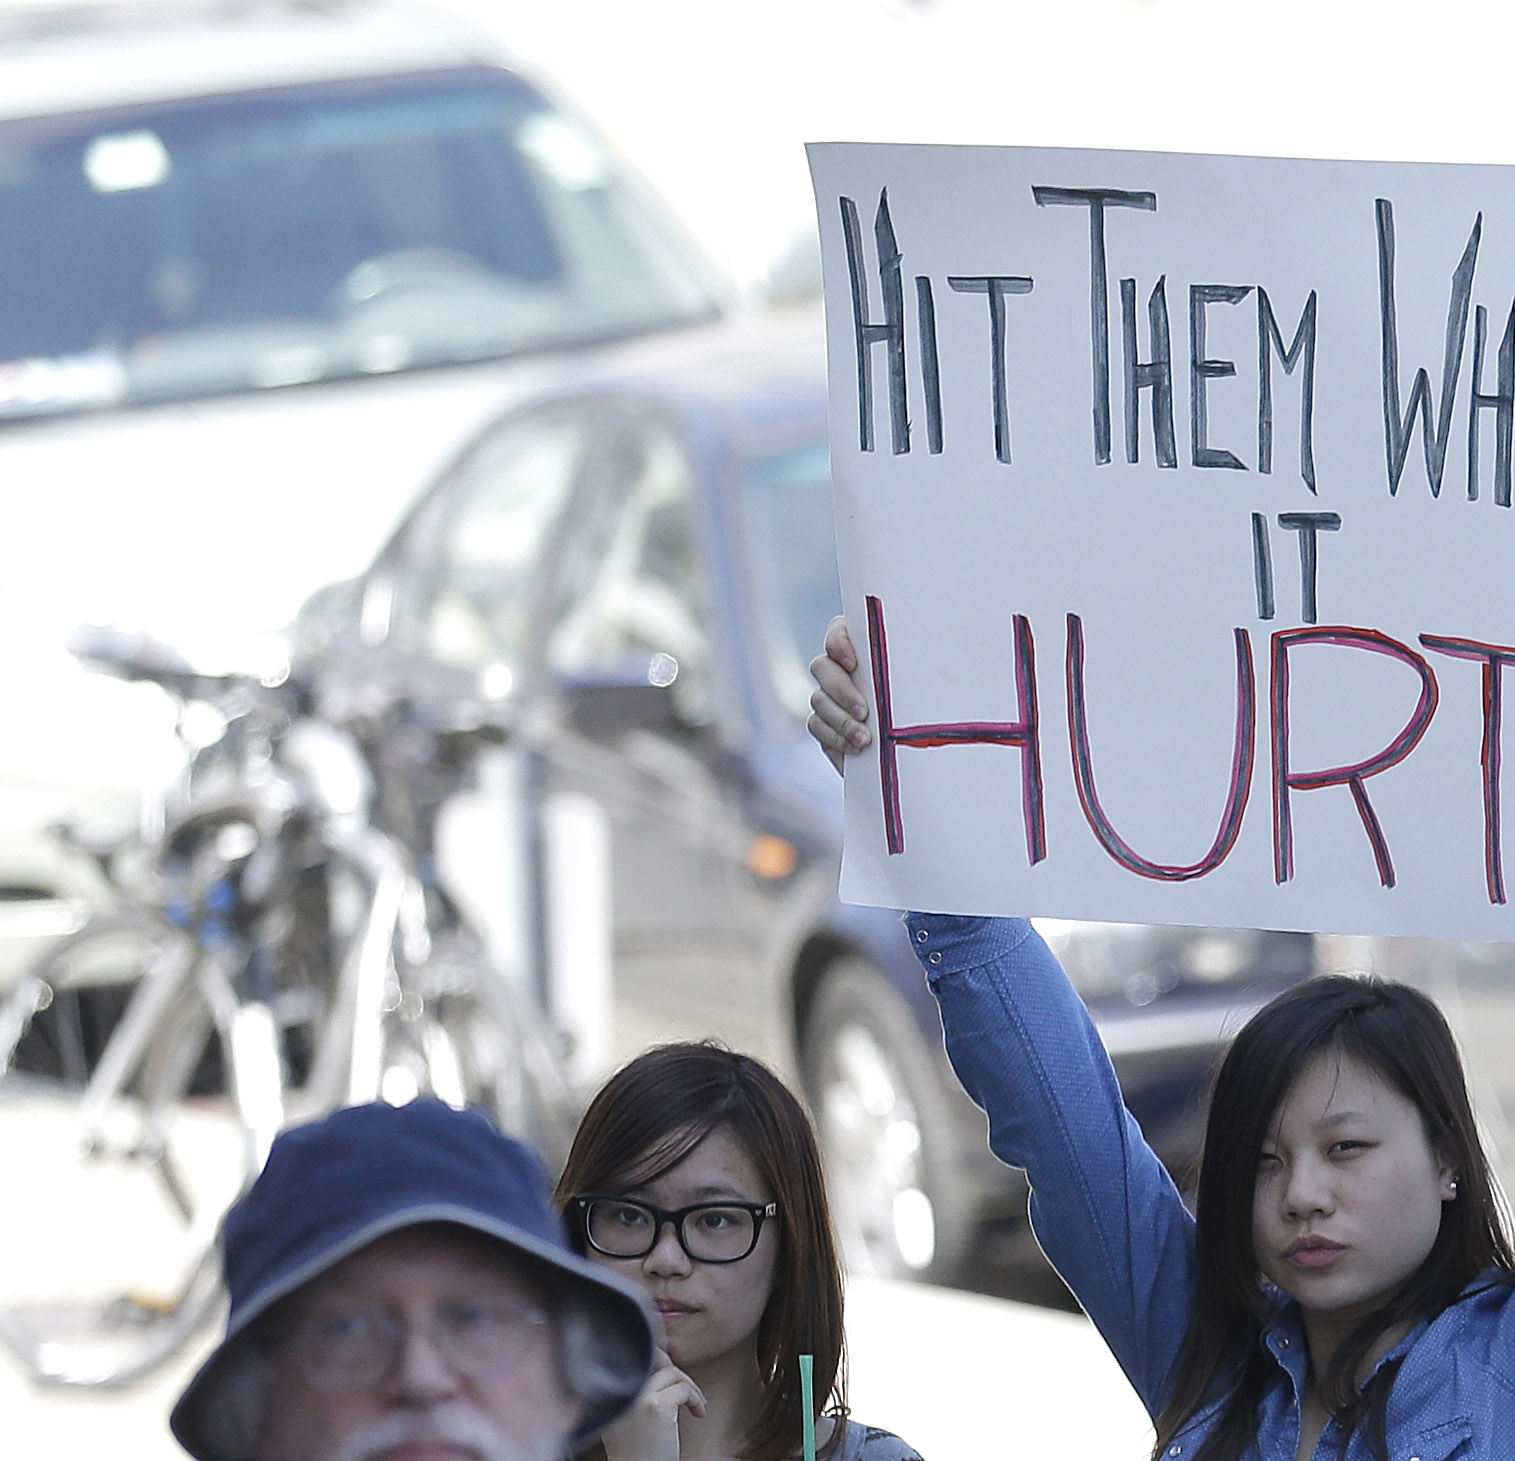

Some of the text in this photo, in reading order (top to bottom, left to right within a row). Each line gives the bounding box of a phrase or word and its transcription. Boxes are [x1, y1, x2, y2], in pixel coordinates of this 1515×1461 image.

[840, 187, 1033, 463] HIT
[1032, 186, 1317, 495] THEM
[1252, 512, 1341, 624] IT
